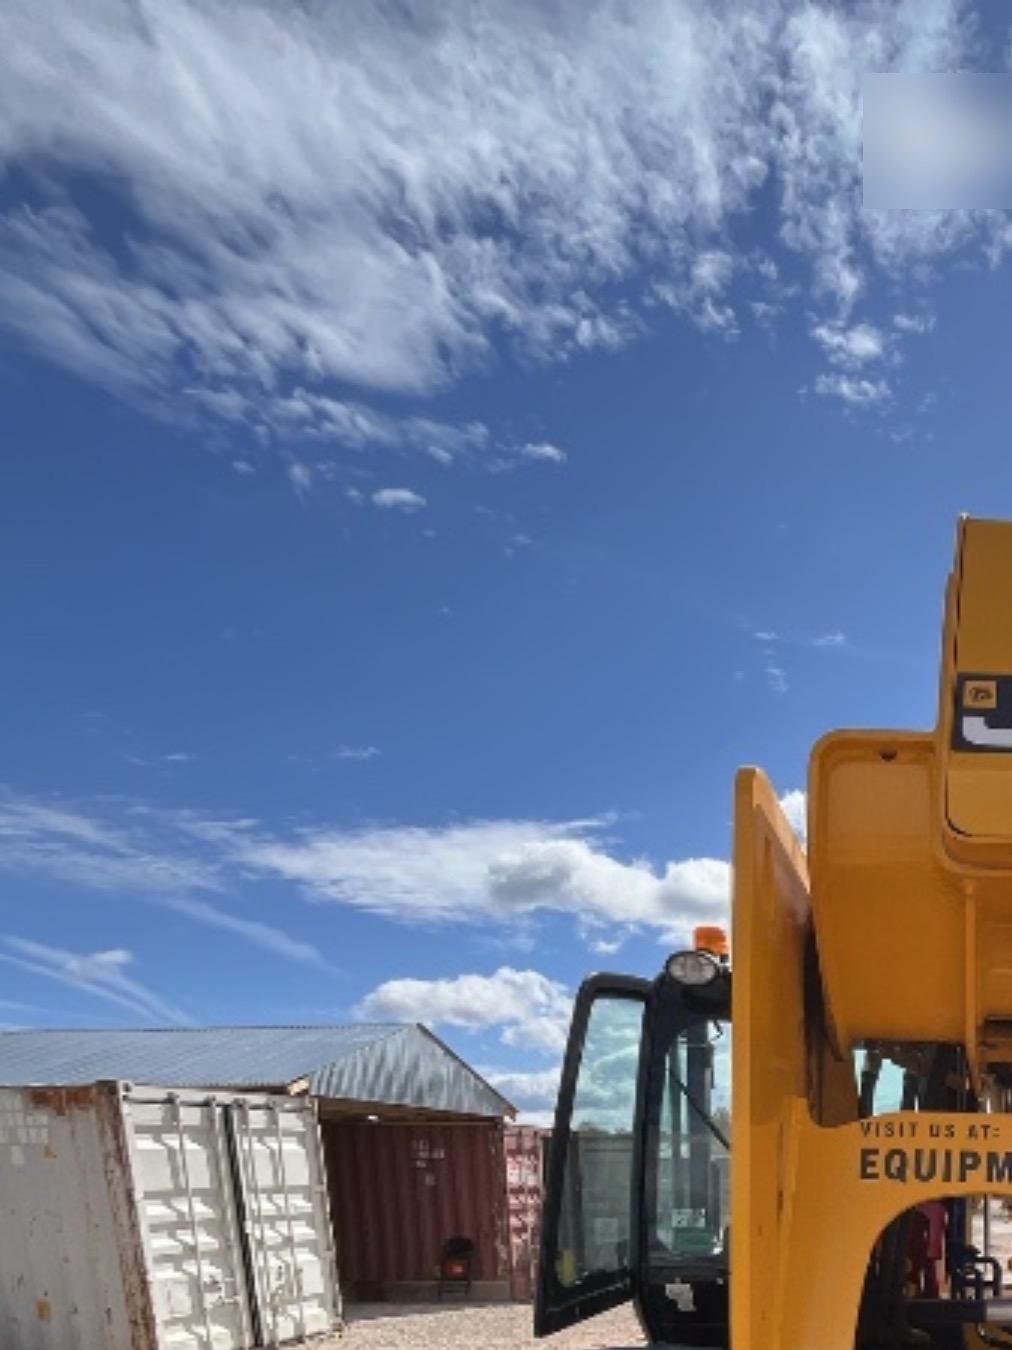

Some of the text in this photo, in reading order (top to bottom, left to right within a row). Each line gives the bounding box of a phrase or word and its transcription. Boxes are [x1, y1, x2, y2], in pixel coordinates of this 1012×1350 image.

[861, 1121, 1000, 1140] VISIT US AT:
